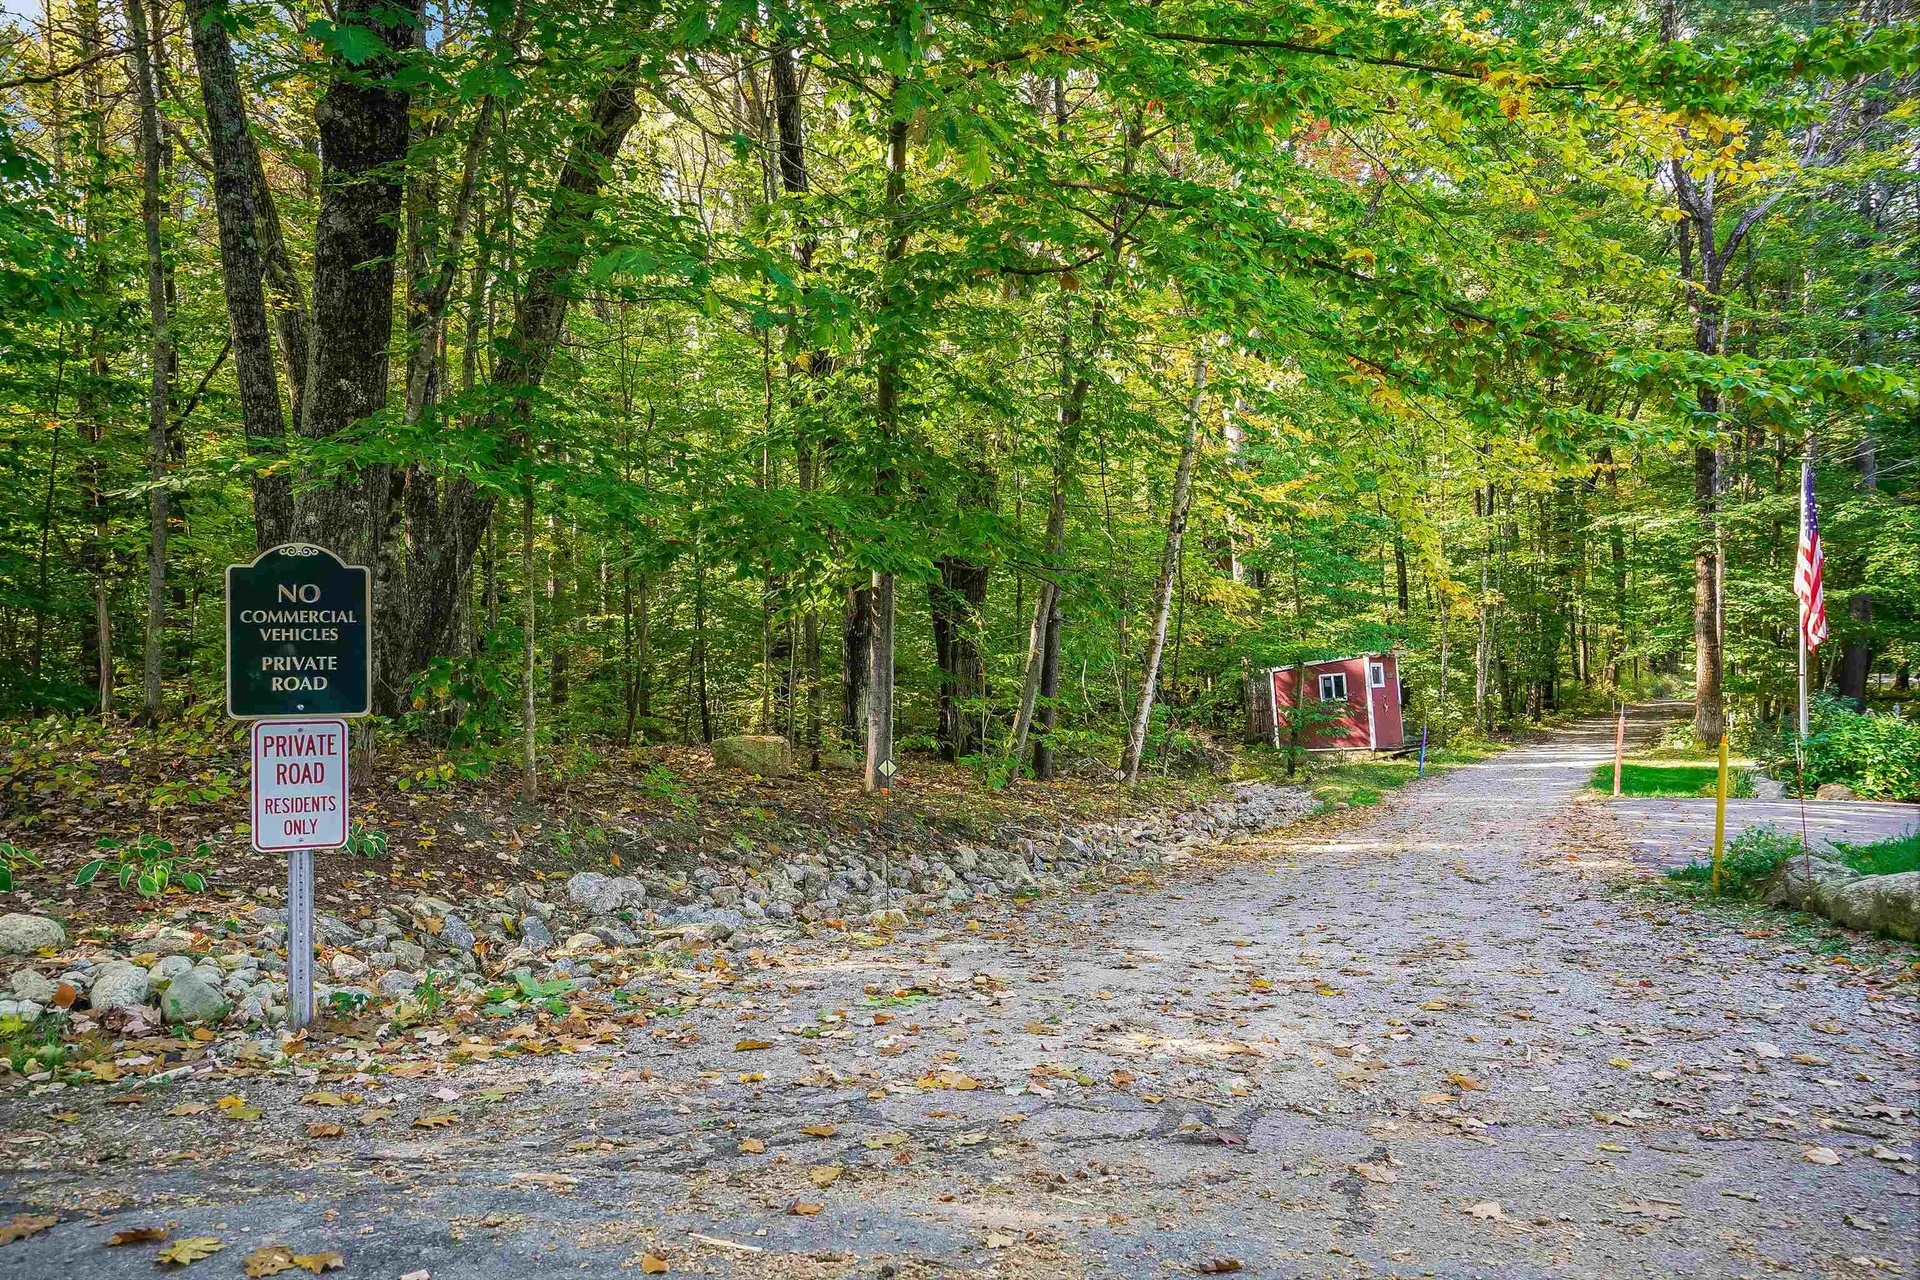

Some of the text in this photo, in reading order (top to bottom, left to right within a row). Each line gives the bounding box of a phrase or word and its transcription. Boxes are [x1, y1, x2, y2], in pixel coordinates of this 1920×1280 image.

[278, 584, 321, 603] NO
[240, 610, 357, 624] COMMERCIAL
[260, 628, 339, 642] VEHICLES
[261, 656, 338, 671] PRIVATE
[271, 676, 328, 691] ROAD
[263, 734, 337, 757] PRIVATE
[276, 762, 325, 785] ROAD
[265, 795, 336, 814] RESIDENTS
[283, 818, 318, 836] ONLY
